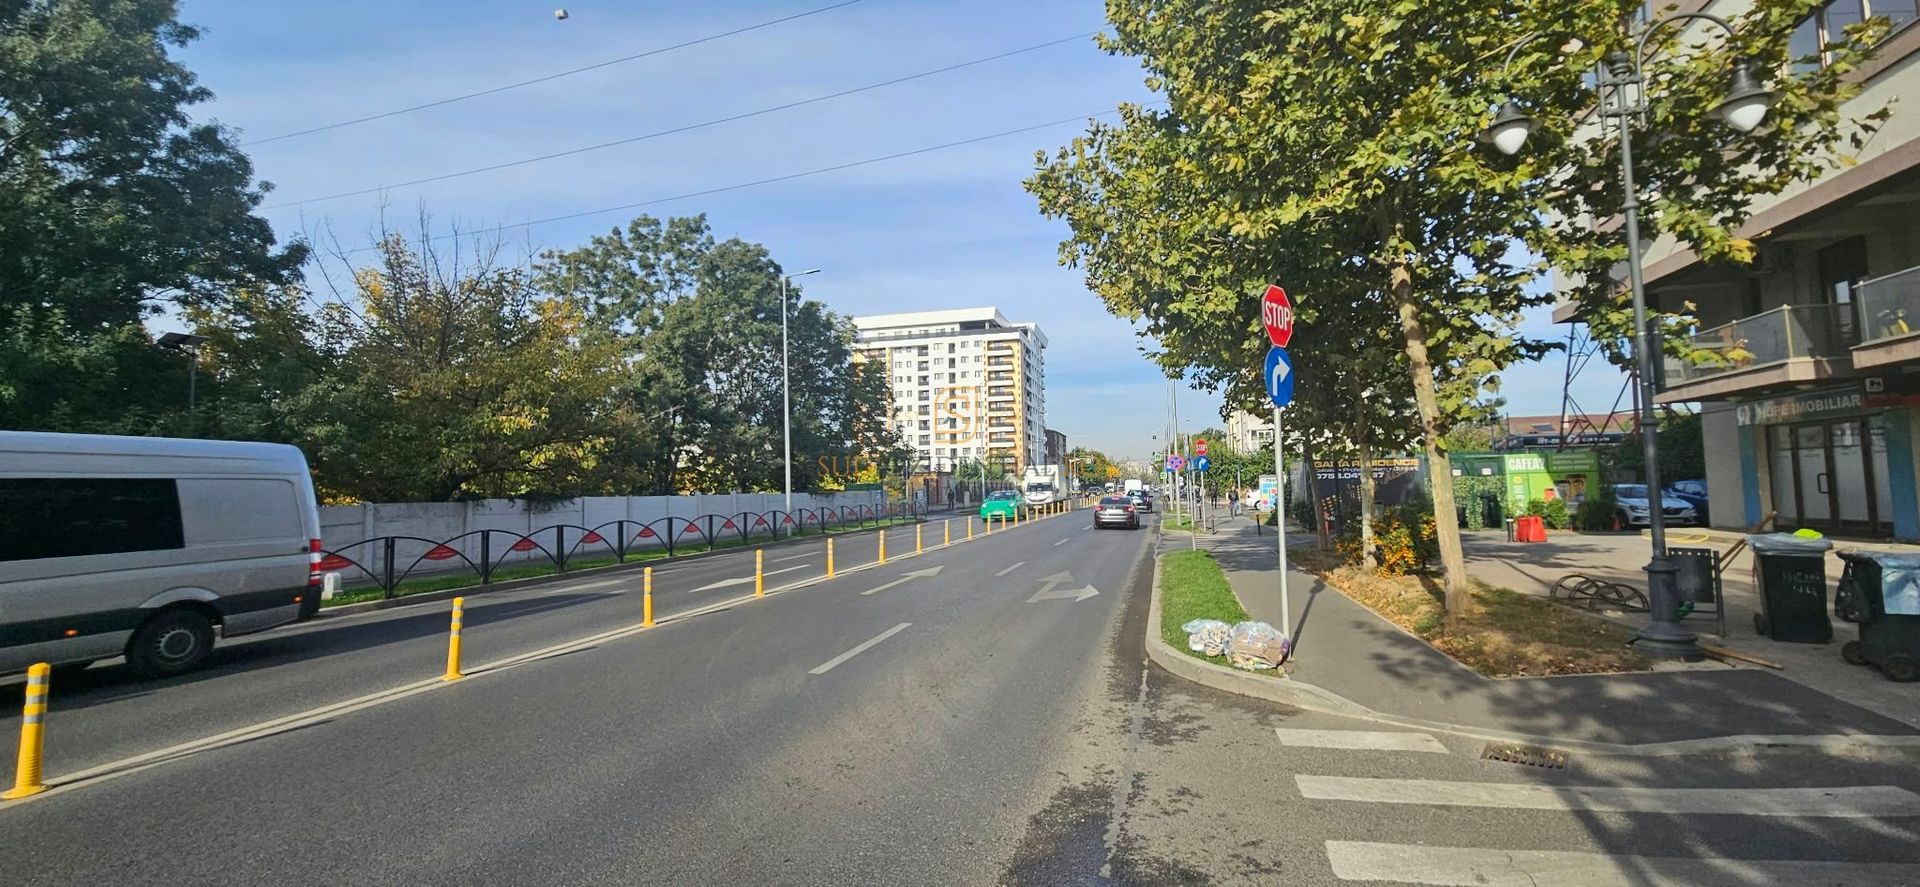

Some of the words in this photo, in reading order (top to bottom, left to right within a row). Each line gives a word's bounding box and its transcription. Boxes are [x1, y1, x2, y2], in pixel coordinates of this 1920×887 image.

[1265, 301, 1291, 331] STOP
[1791, 394, 1862, 416] IMOBILIAR
[1195, 444, 1208, 453] STOP
[1352, 458, 1419, 468] RIDENCE
